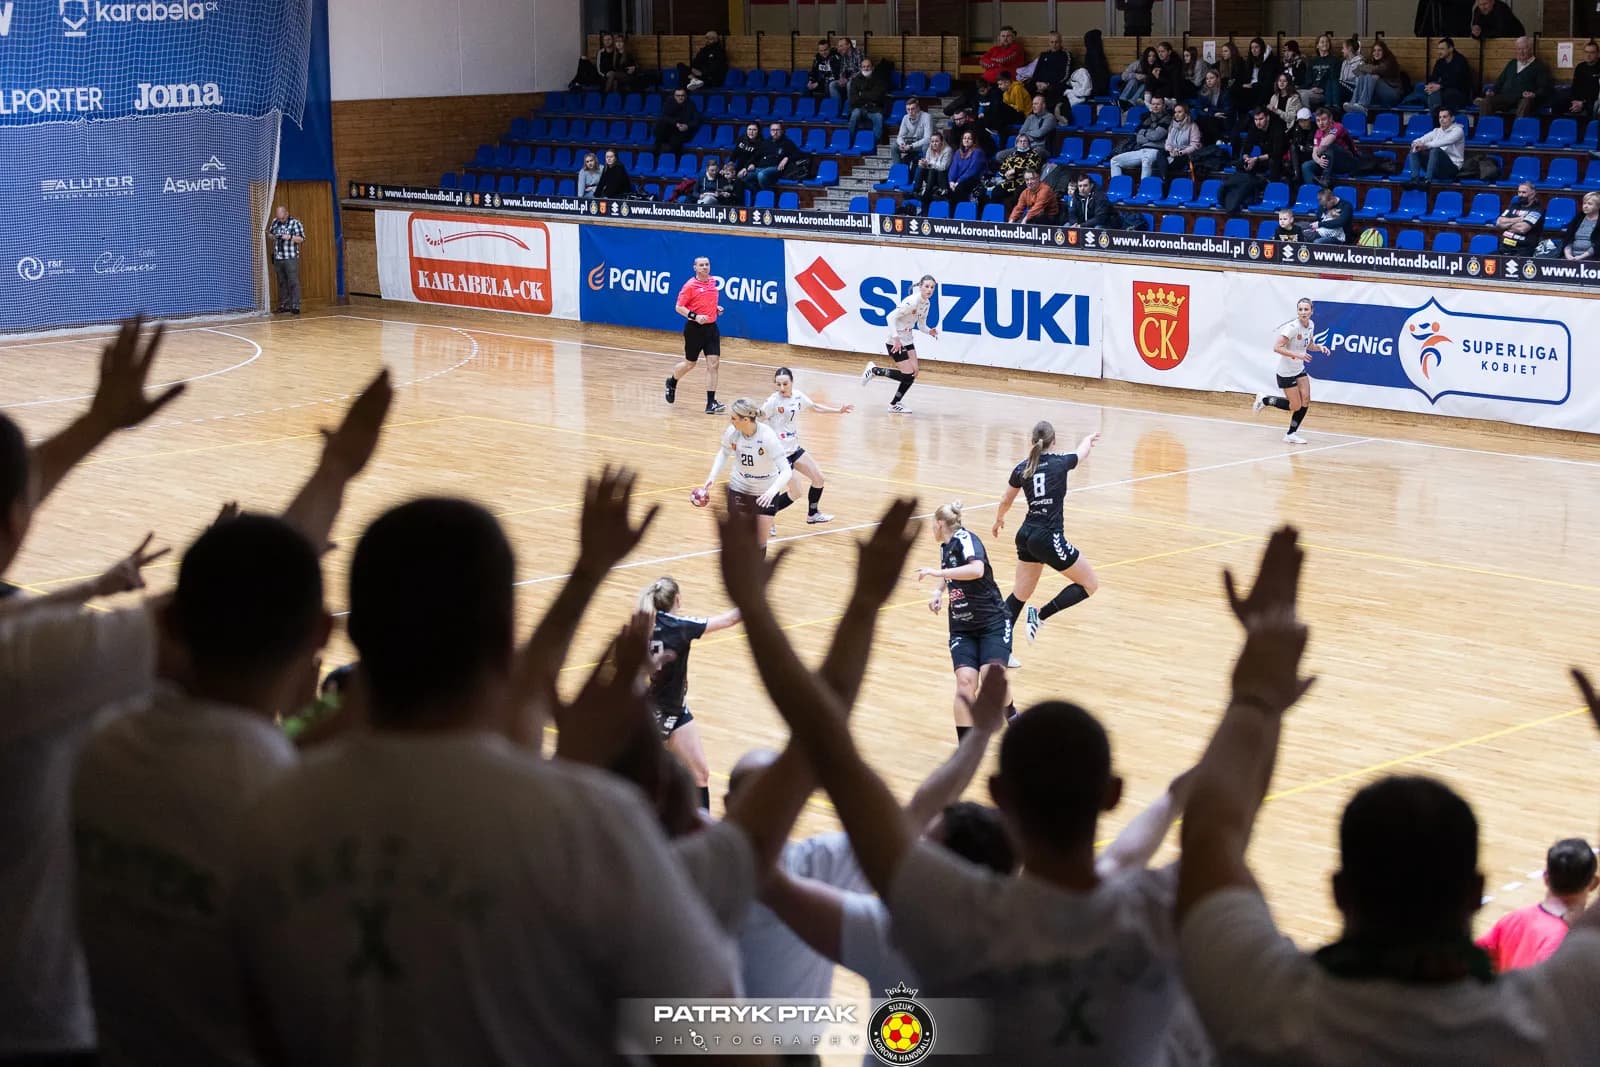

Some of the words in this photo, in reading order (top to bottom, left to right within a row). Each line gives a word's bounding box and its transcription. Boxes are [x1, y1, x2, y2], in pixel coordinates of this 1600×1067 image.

[96, 0, 204, 22] karabela
[134, 82, 223, 110] Joma
[54, 175, 134, 190] ALUTOR
[163, 176, 228, 193] Aswent
[384, 187, 463, 206] www.koronahandball.pl
[502, 196, 588, 213] www.koronahandball.pl
[631, 203, 727, 223] www.koronahandball.pl
[933, 222, 1051, 245] www.koronahandball.pl
[1113, 234, 1244, 259] www.koronahandball.pl
[1314, 247, 1463, 275] www.koronahandball.pl
[417, 270, 545, 301] KARABELA-CK
[609, 267, 671, 295] PGNiG
[1138, 316, 1179, 361] CK
[1331, 332, 1393, 356] PGNiG
[1462, 339, 1559, 362] SUPERLIGA
[1481, 360, 1537, 376] KOBIET
[790, 409, 796, 421] 7
[741, 453, 754, 467] 28
[1033, 472, 1045, 498] 8
